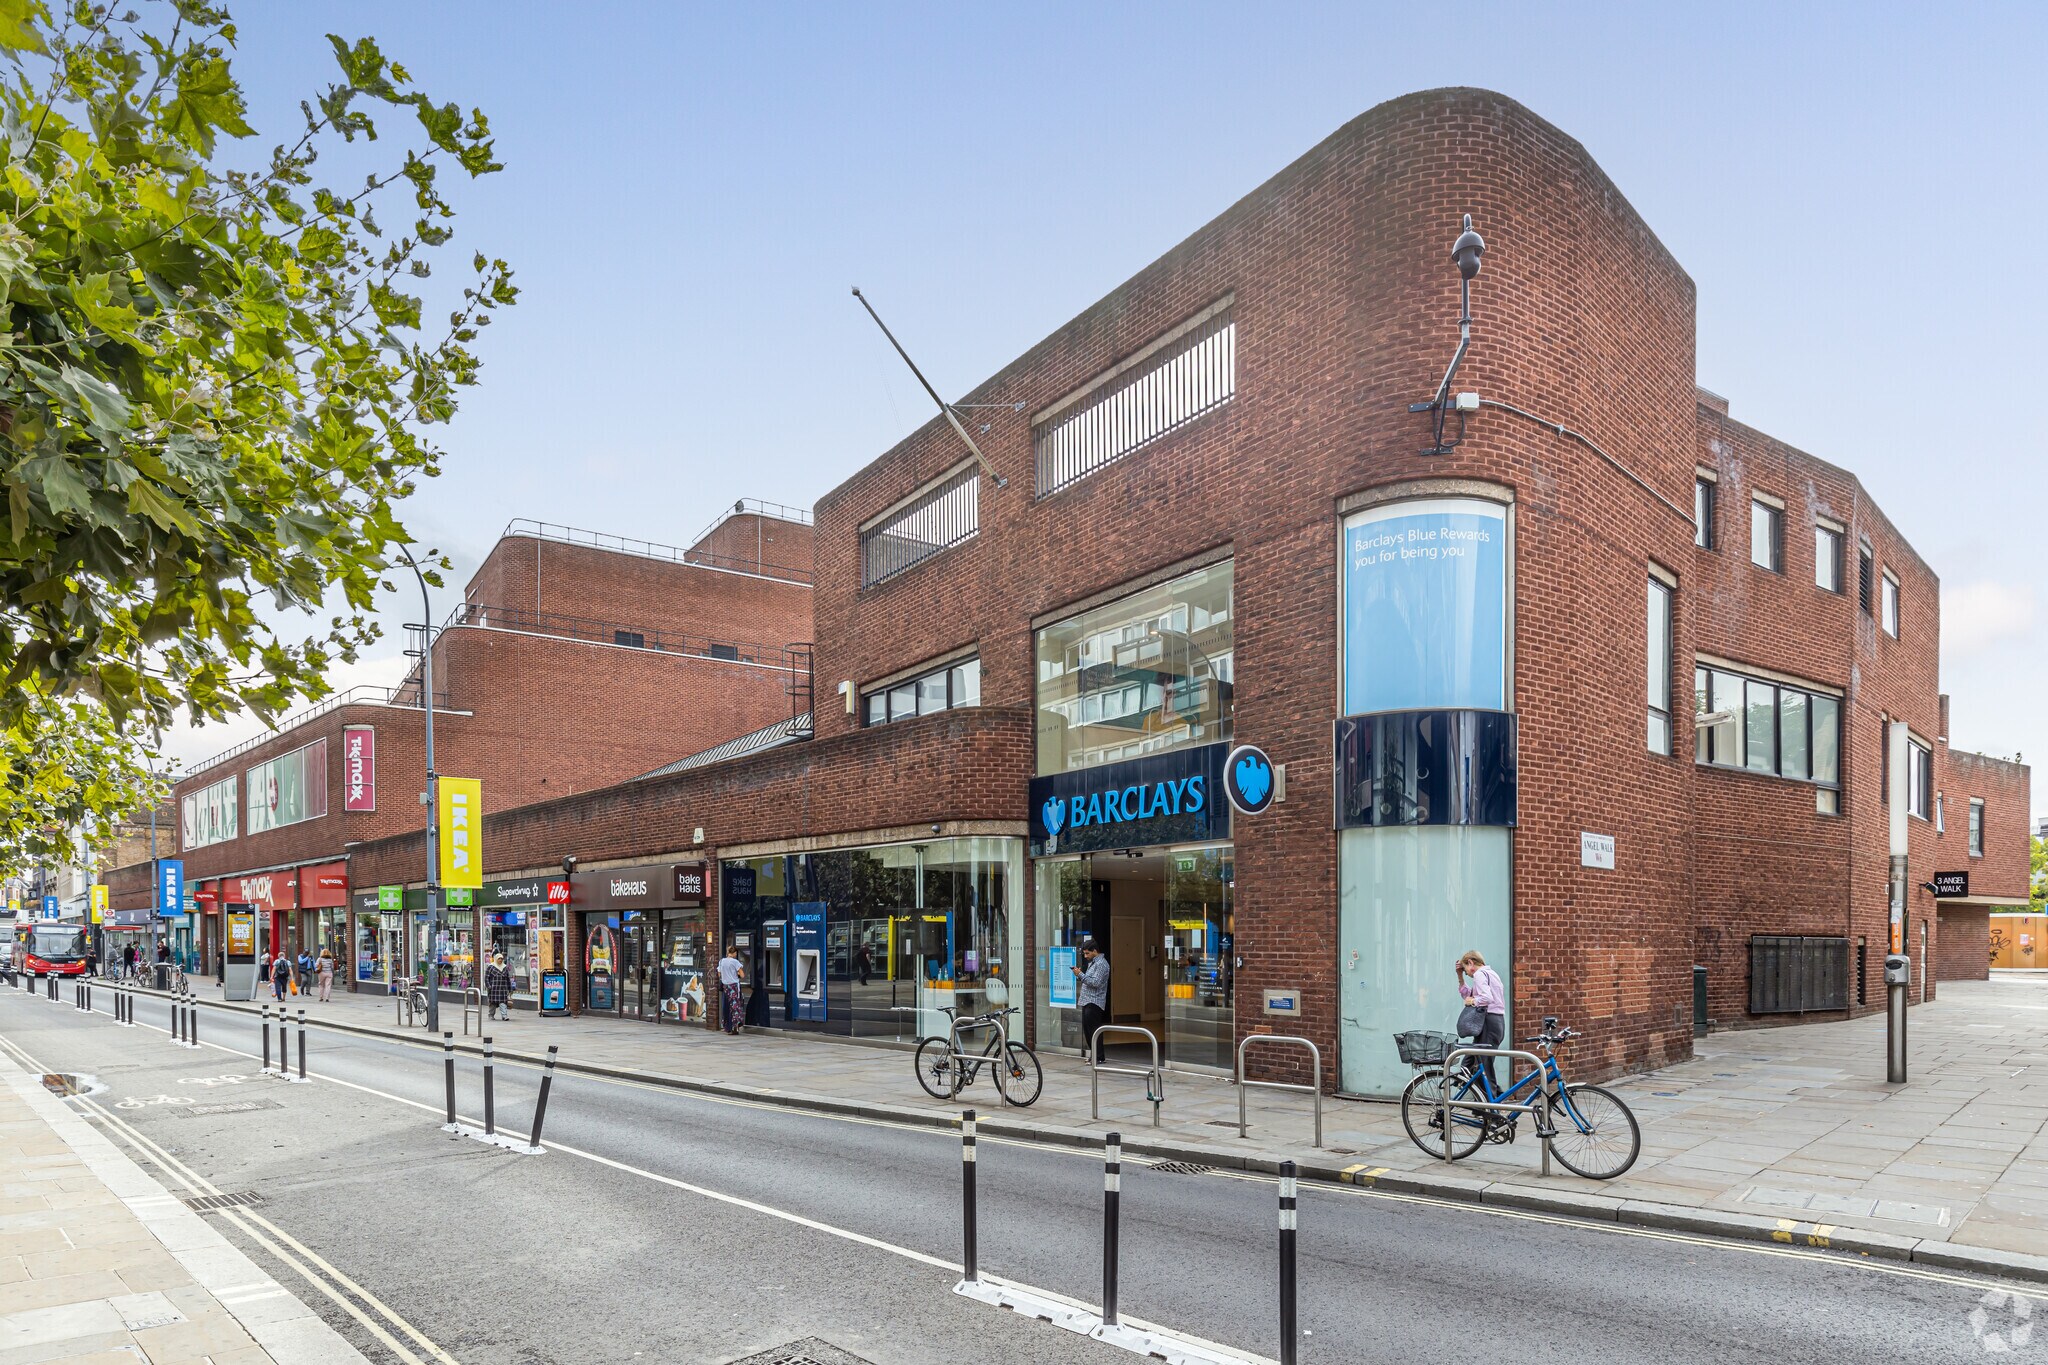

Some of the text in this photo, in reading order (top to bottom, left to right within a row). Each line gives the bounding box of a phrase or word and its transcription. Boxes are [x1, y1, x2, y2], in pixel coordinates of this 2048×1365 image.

[1355, 527, 1490, 552] Barclays Blue Rewards
[1354, 546, 1465, 571] you for being you
[1070, 776, 1205, 828] BARCLAYS
[452, 794, 468, 870] IKEA
[1584, 840, 1613, 853] ANGEL WALK
[166, 868, 177, 908] IKEA
[1937, 877, 1965, 885] 3 ANGEL
[1940, 885, 1962, 893] WALK
[498, 886, 531, 899] Superdrug
[549, 885, 569, 902] illy
